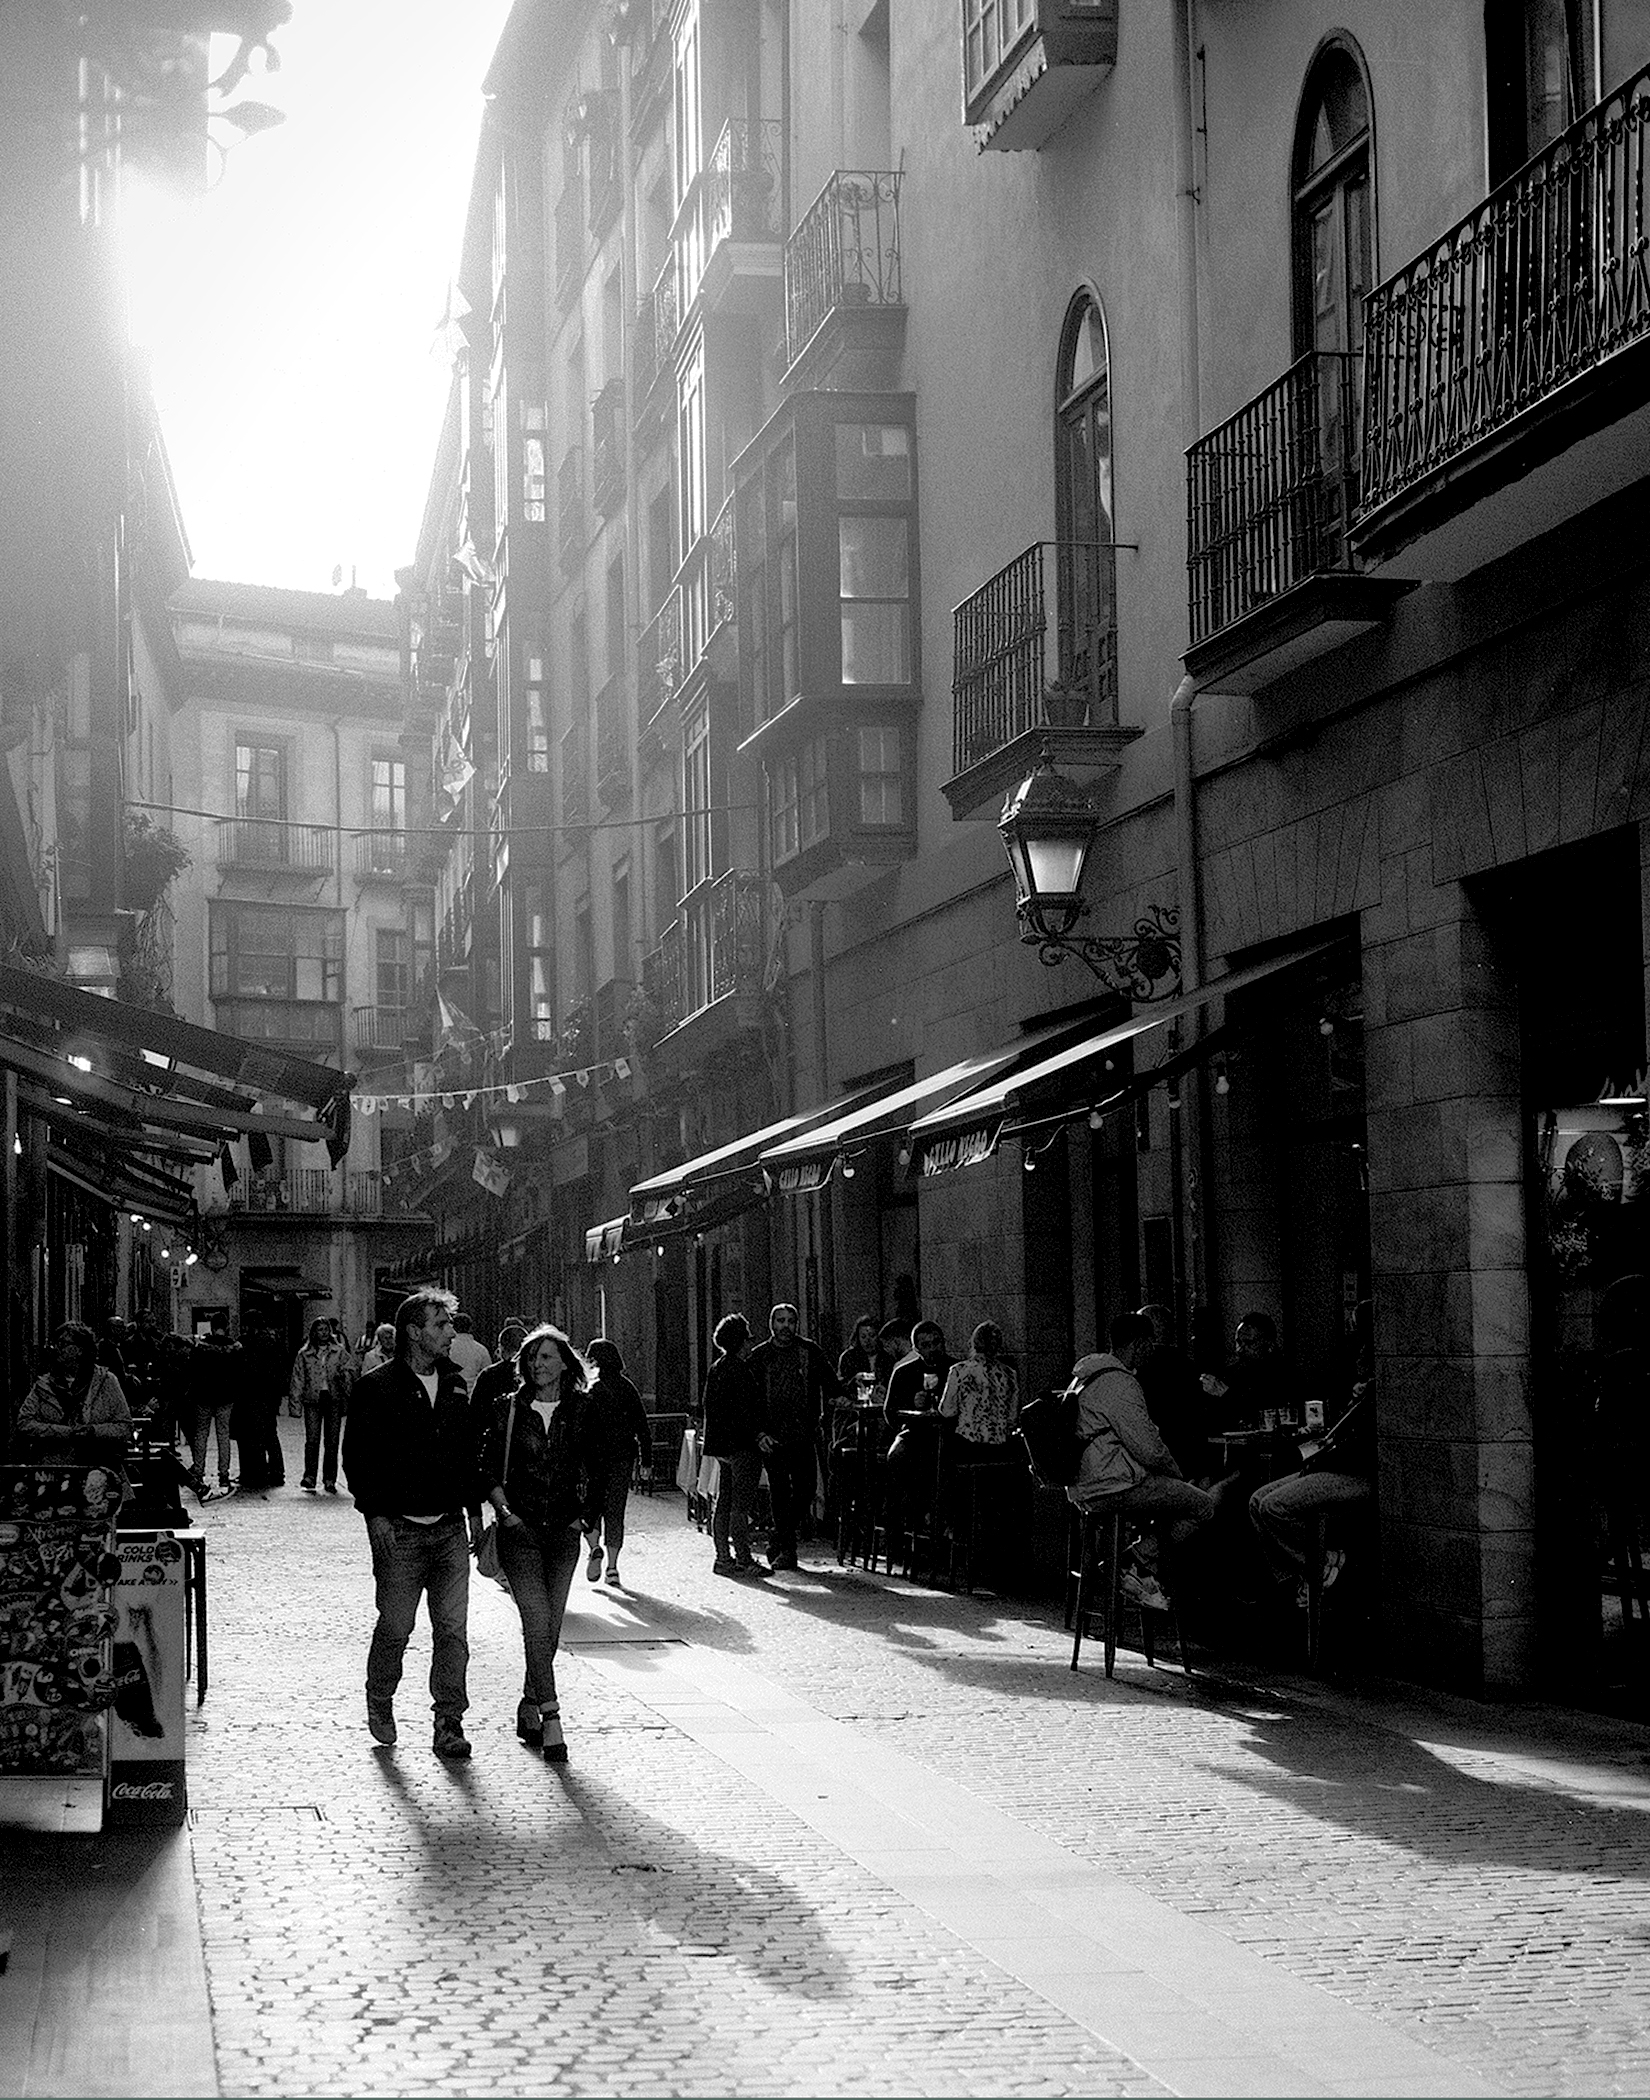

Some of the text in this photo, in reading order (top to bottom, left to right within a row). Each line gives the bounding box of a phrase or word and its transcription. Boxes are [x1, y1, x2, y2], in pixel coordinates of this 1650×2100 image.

[123, 1545, 155, 1554] COLD
[117, 1554, 154, 1563] RINKS
[117, 1578, 137, 1586] AKE
[112, 1781, 176, 1799] Coca-Cola
